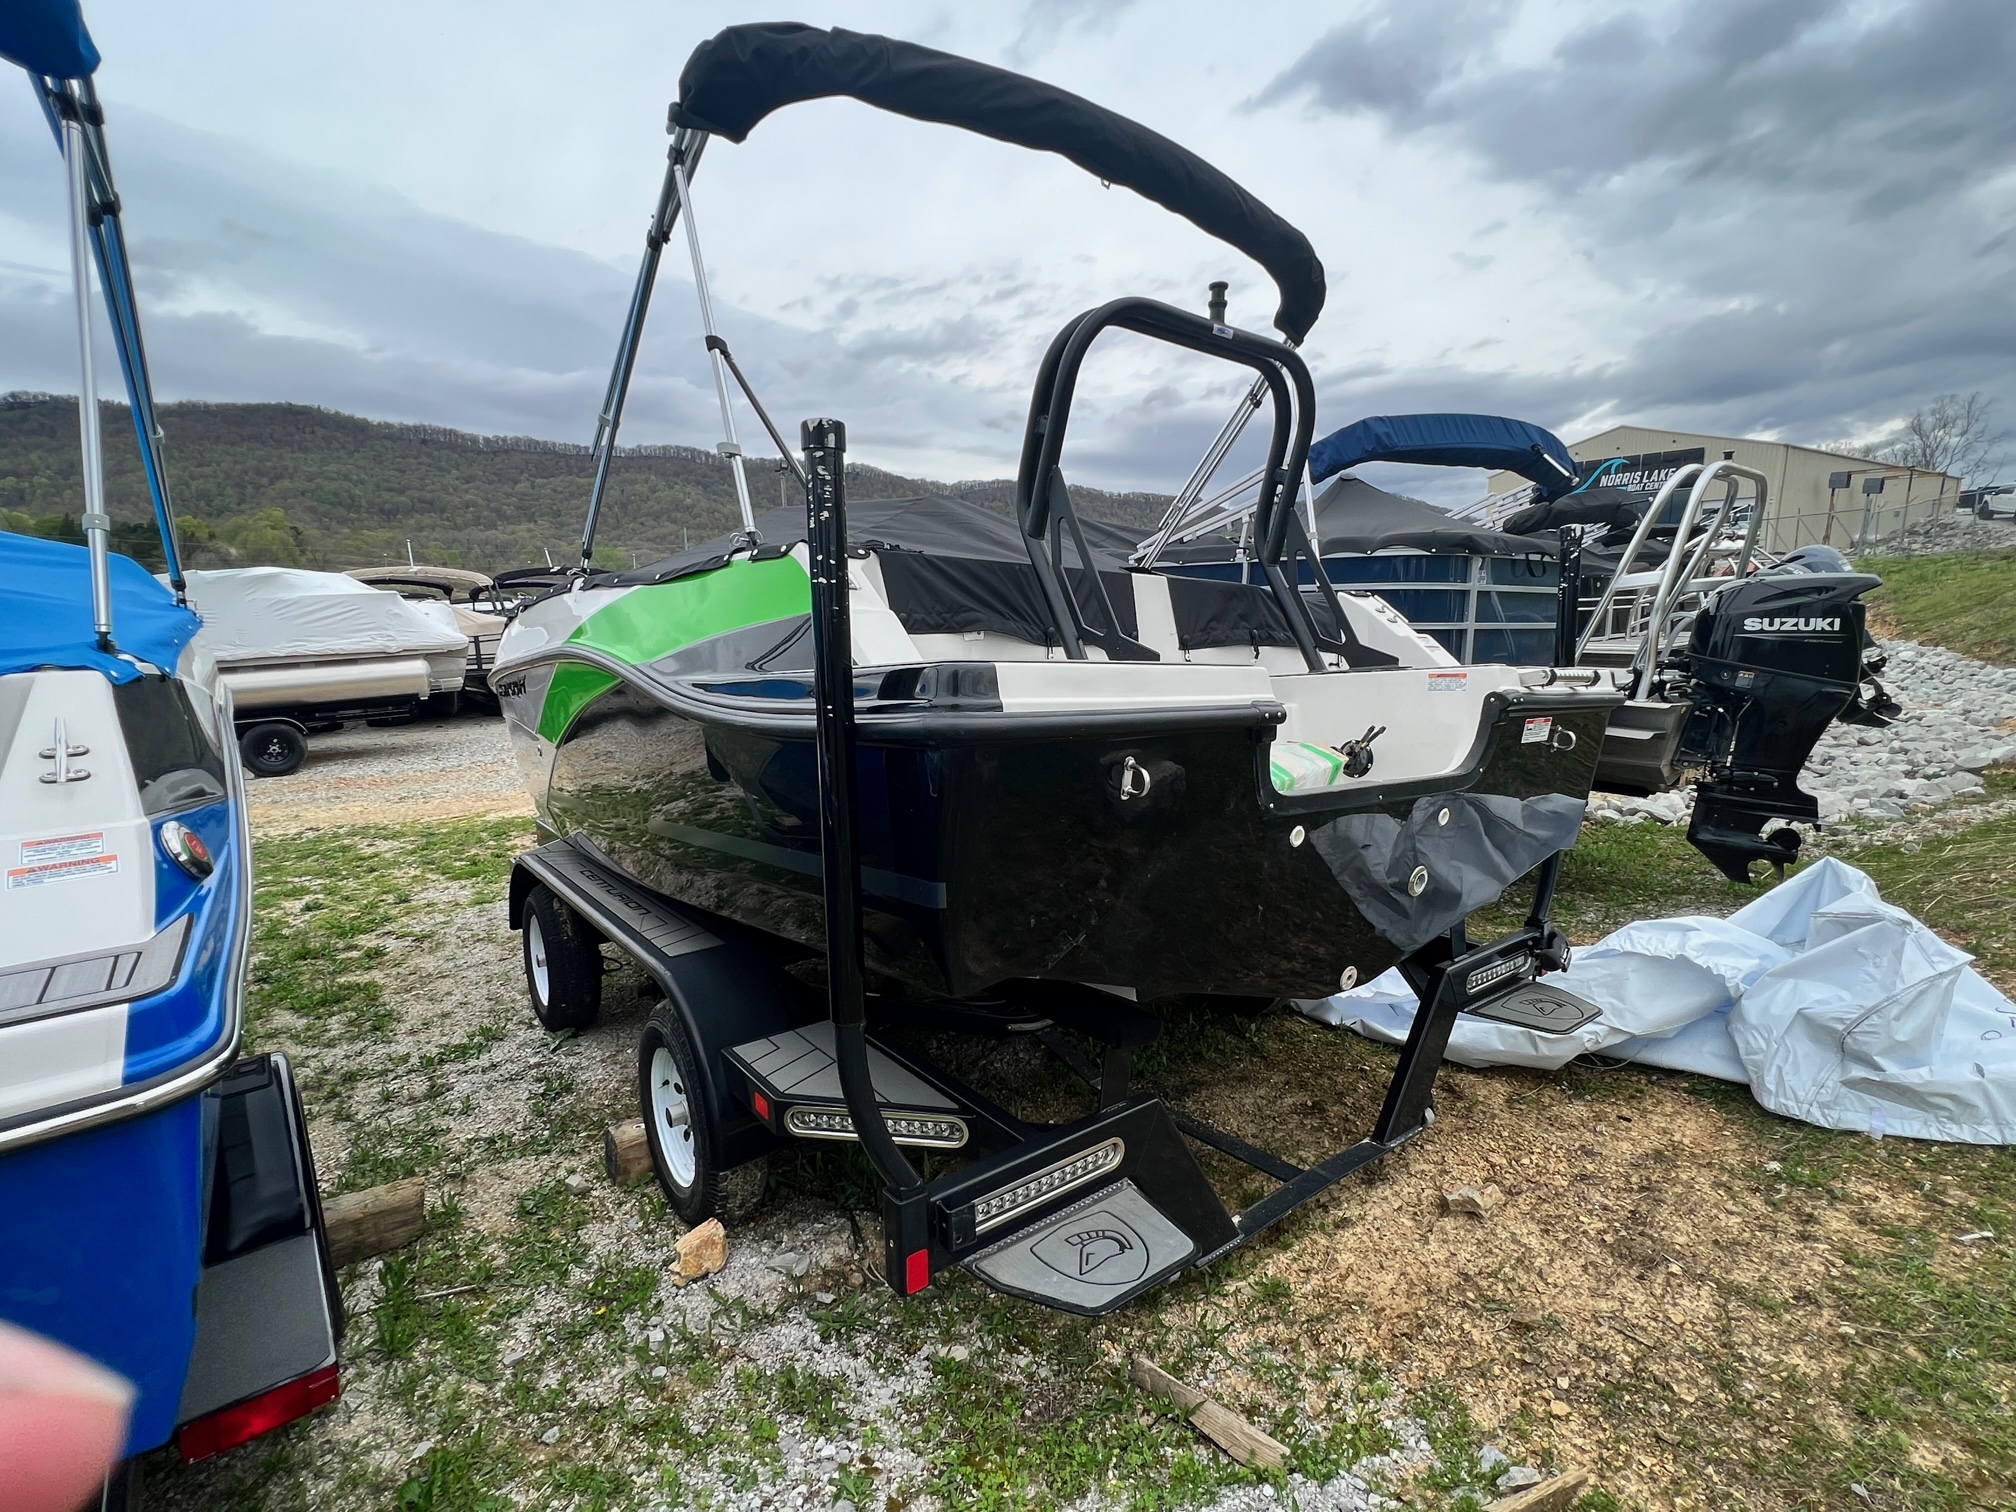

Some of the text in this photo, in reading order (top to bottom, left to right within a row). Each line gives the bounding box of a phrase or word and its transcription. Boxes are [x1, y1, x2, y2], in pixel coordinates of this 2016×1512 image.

[1599, 467, 1677, 487] NORRIS LAKE
[1627, 483, 1645, 492] BOAT
[1743, 617, 1841, 631] SUZUKI
[35, 857, 100, 872] WARNING
[579, 869, 652, 916] CENTURION
